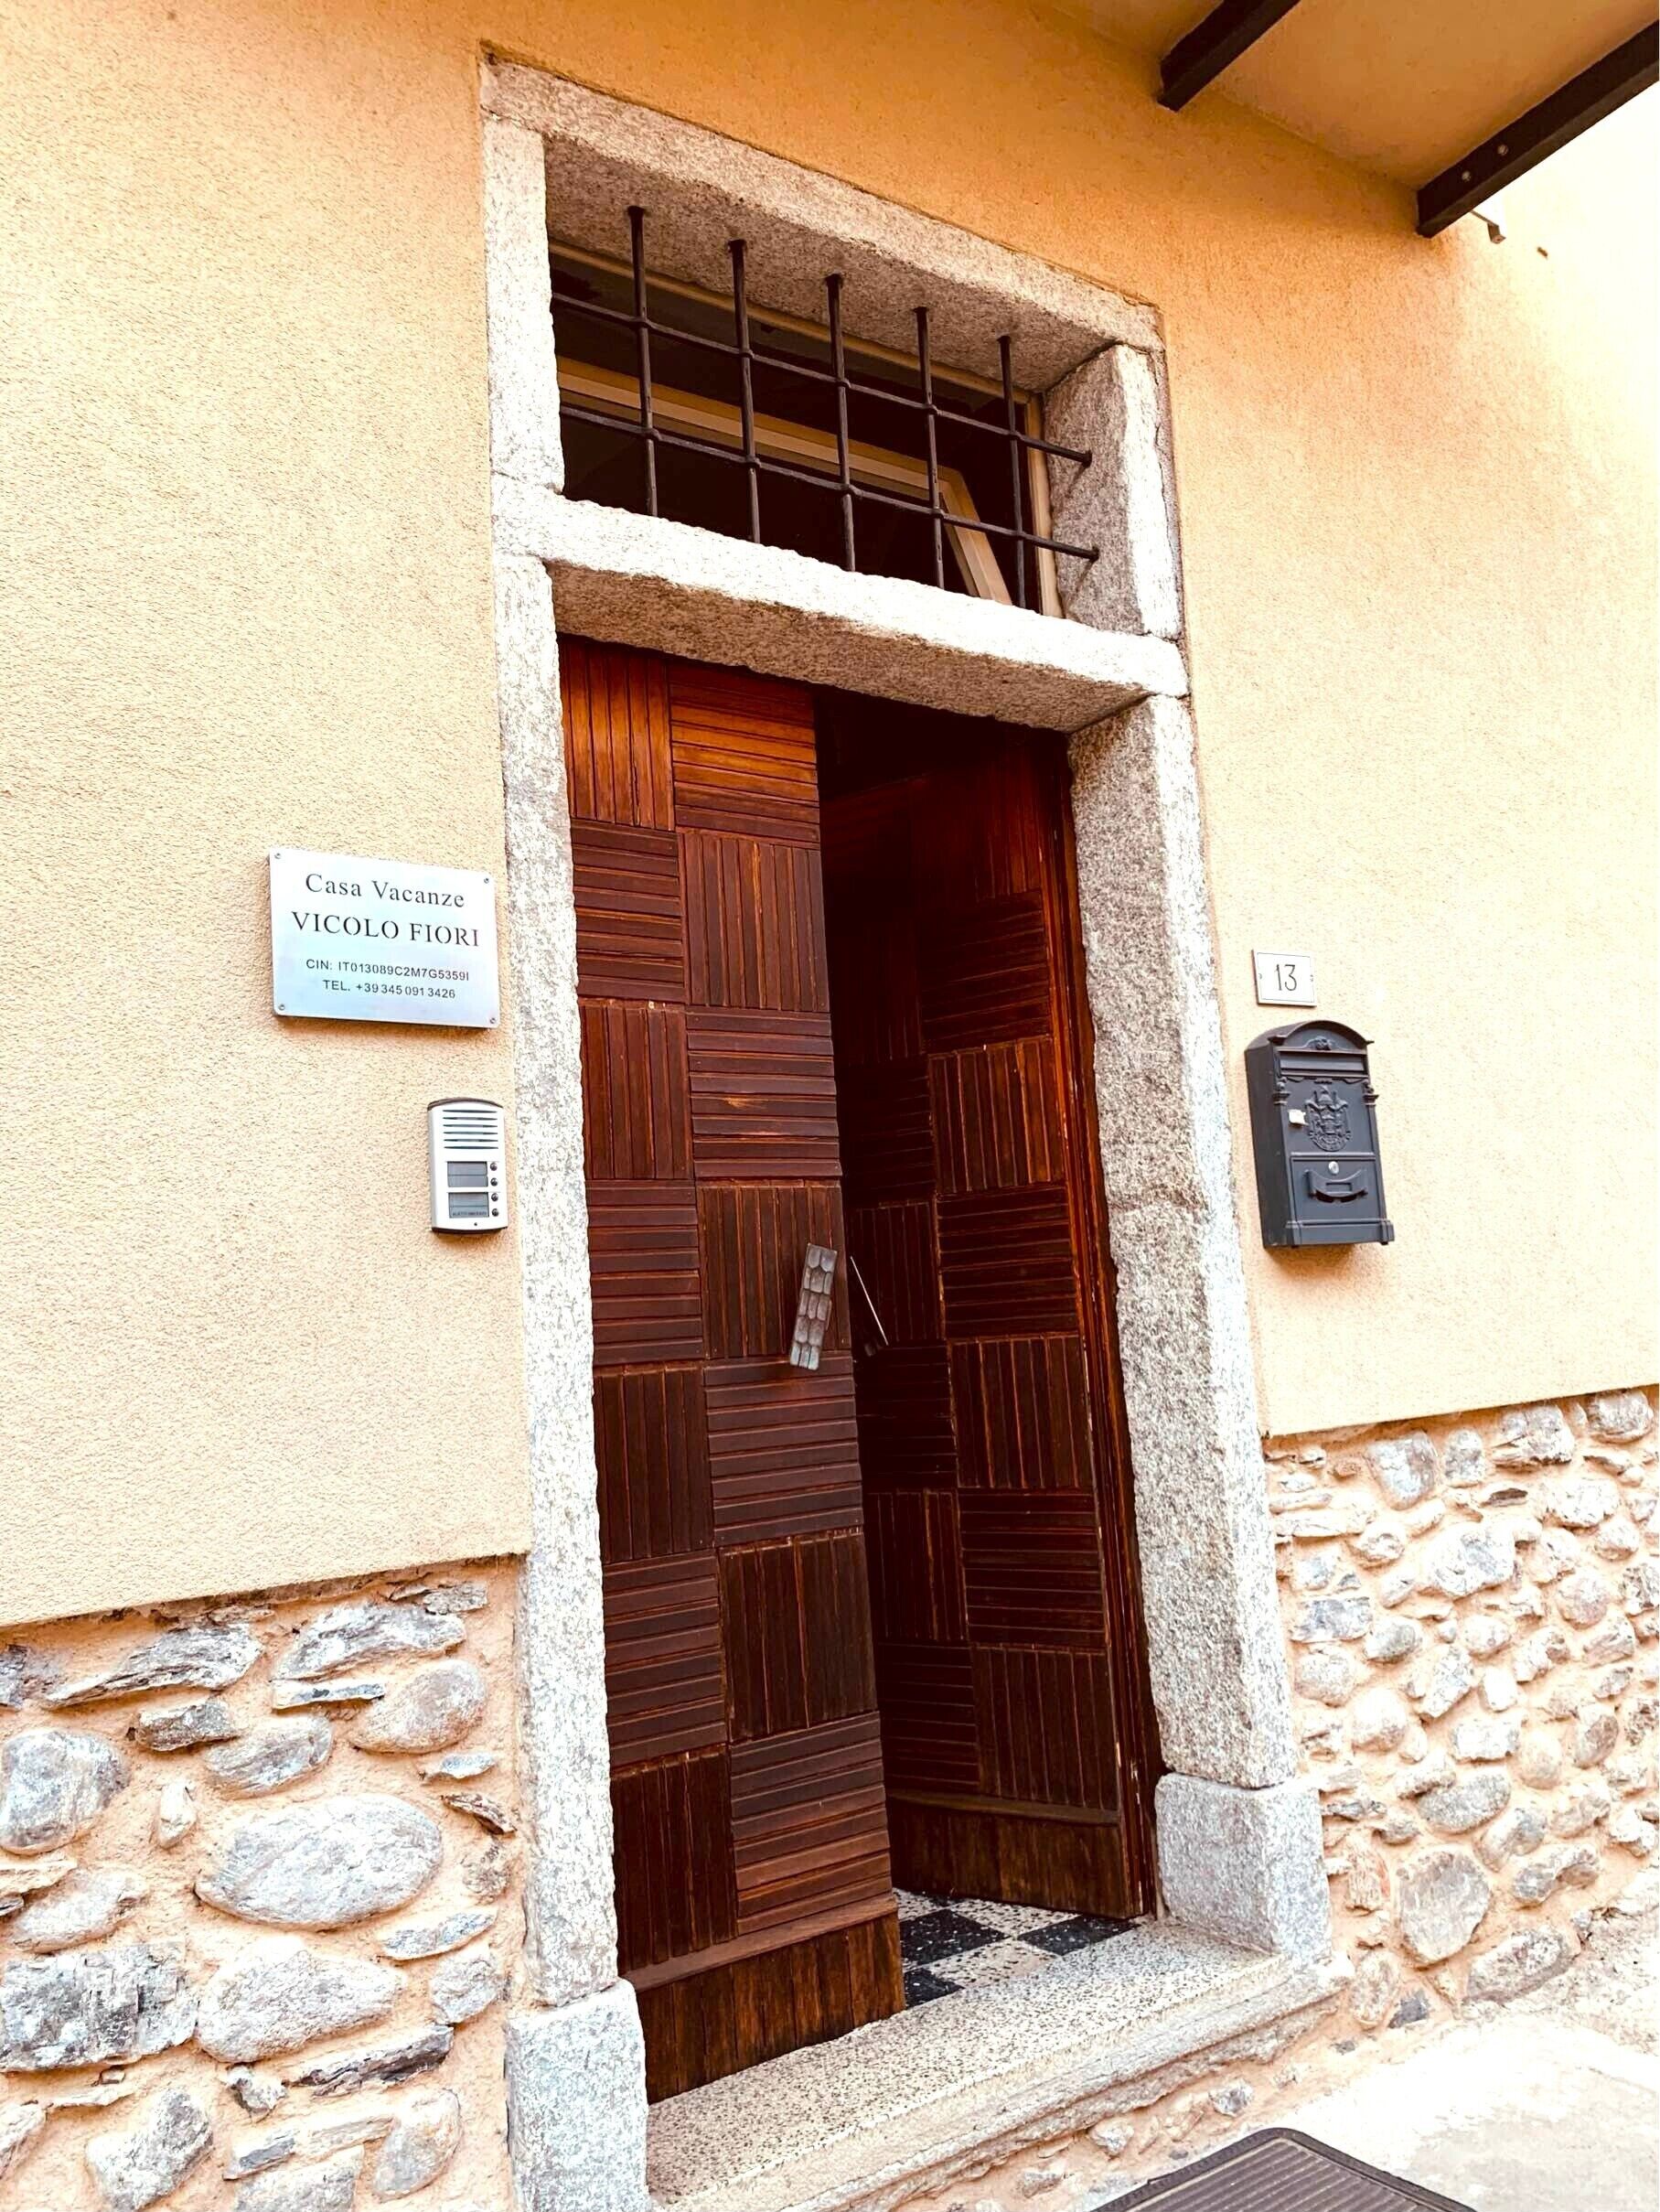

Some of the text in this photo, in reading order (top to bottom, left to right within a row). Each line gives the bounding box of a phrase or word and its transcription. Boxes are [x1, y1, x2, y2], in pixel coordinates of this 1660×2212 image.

[305, 873, 465, 907] Casa Vacanze
[291, 910, 479, 947] VICOLO FIORI
[305, 959, 333, 971] CIN:
[1274, 963, 1297, 992] 13
[322, 979, 350, 992] TEL.
